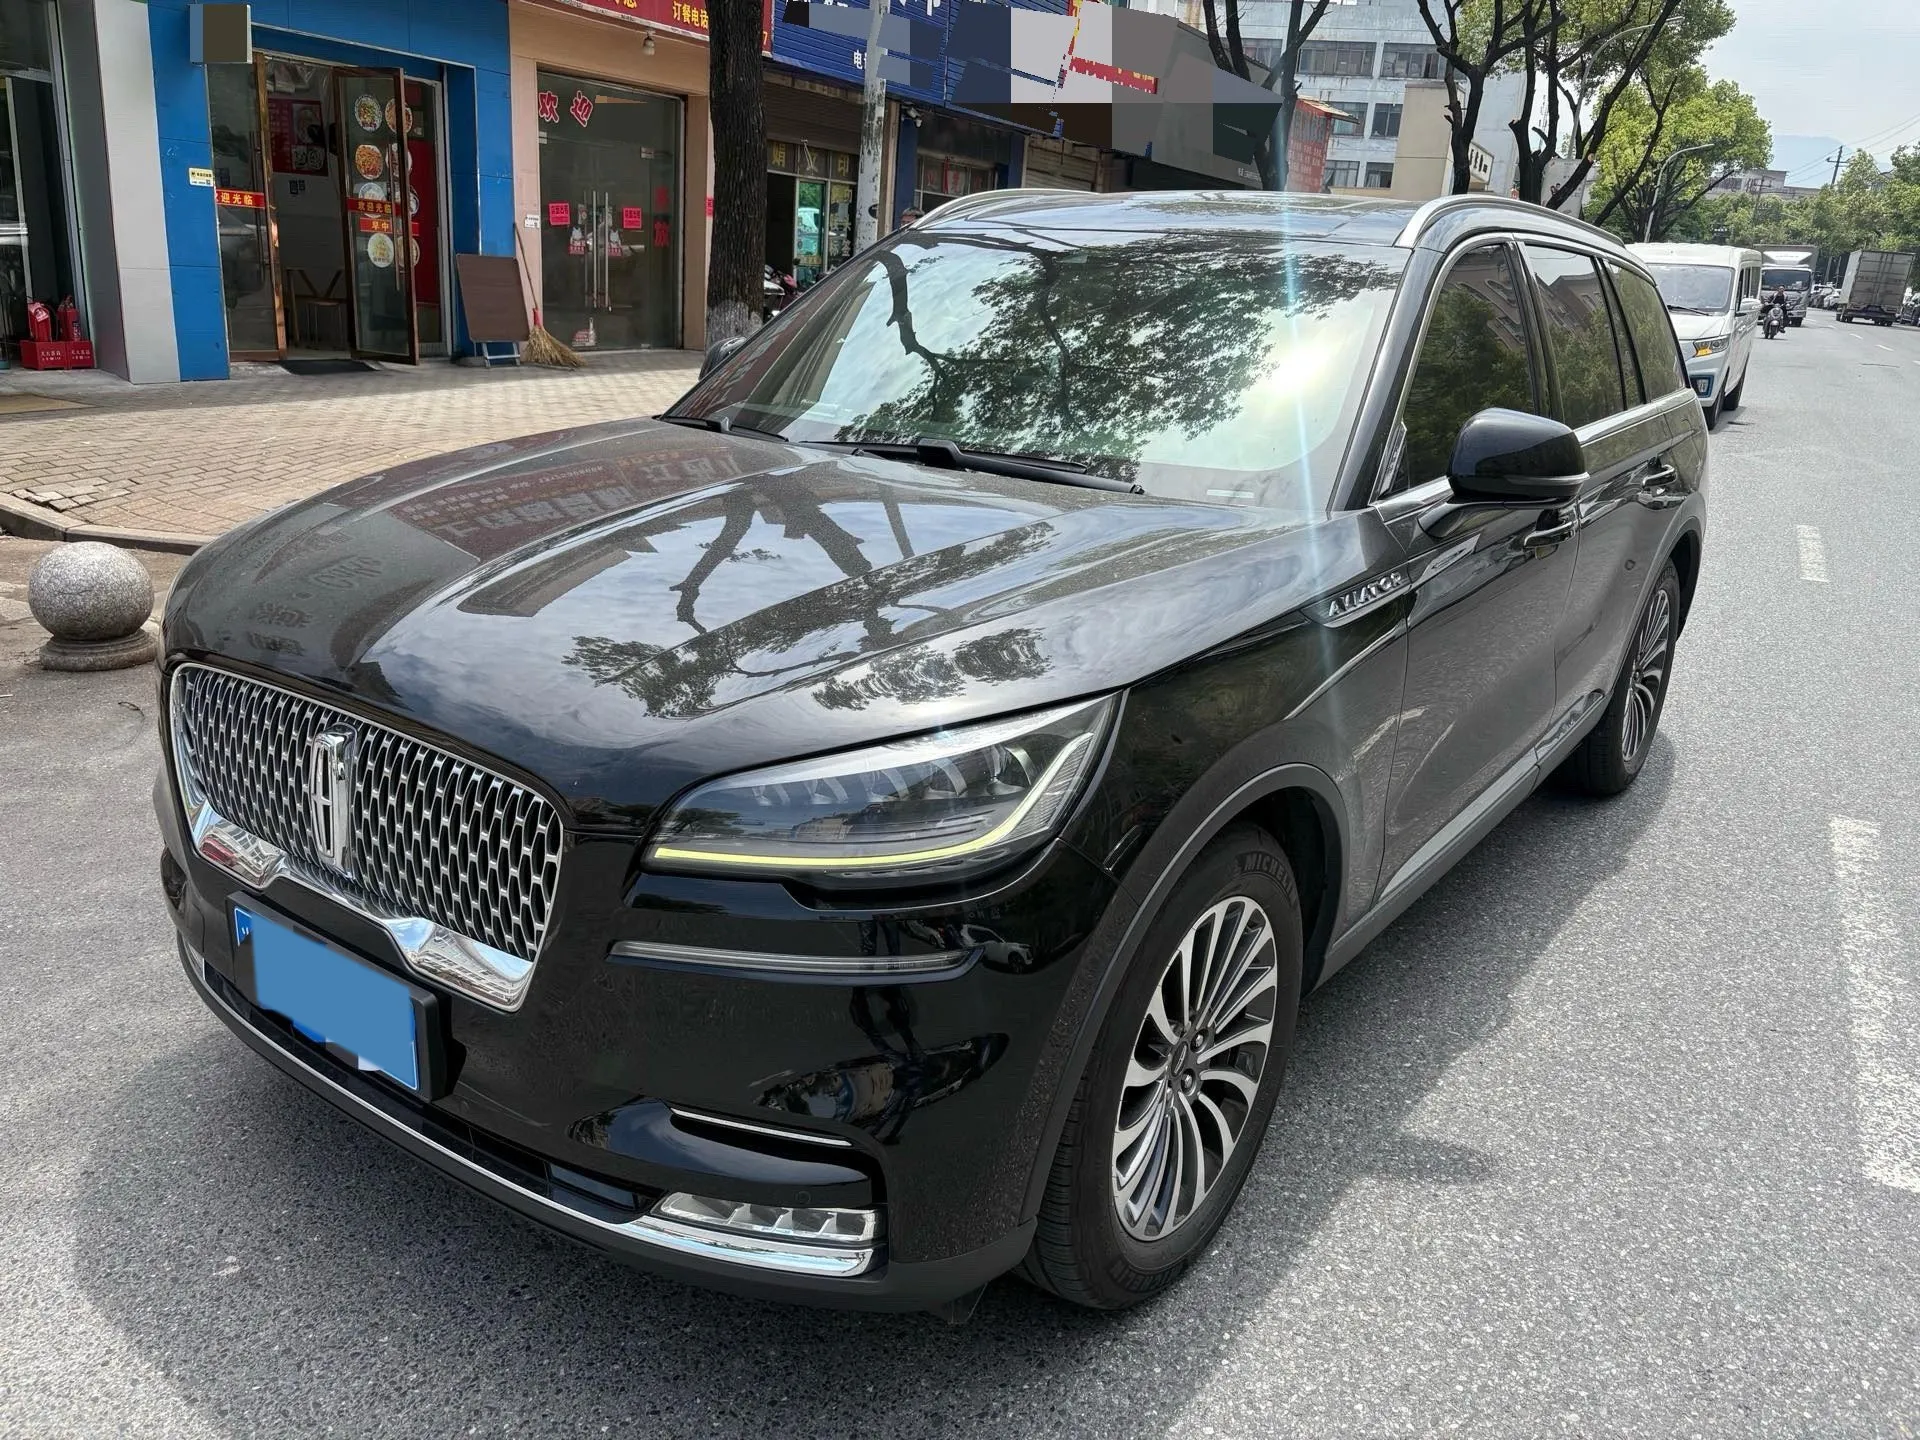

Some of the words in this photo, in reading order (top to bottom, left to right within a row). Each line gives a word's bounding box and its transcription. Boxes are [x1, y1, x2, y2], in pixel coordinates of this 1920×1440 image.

[673, 2, 709, 29] 订餐电话
[538, 90, 593, 127] 欢迎
[1328, 571, 1401, 617] AVIATOR
